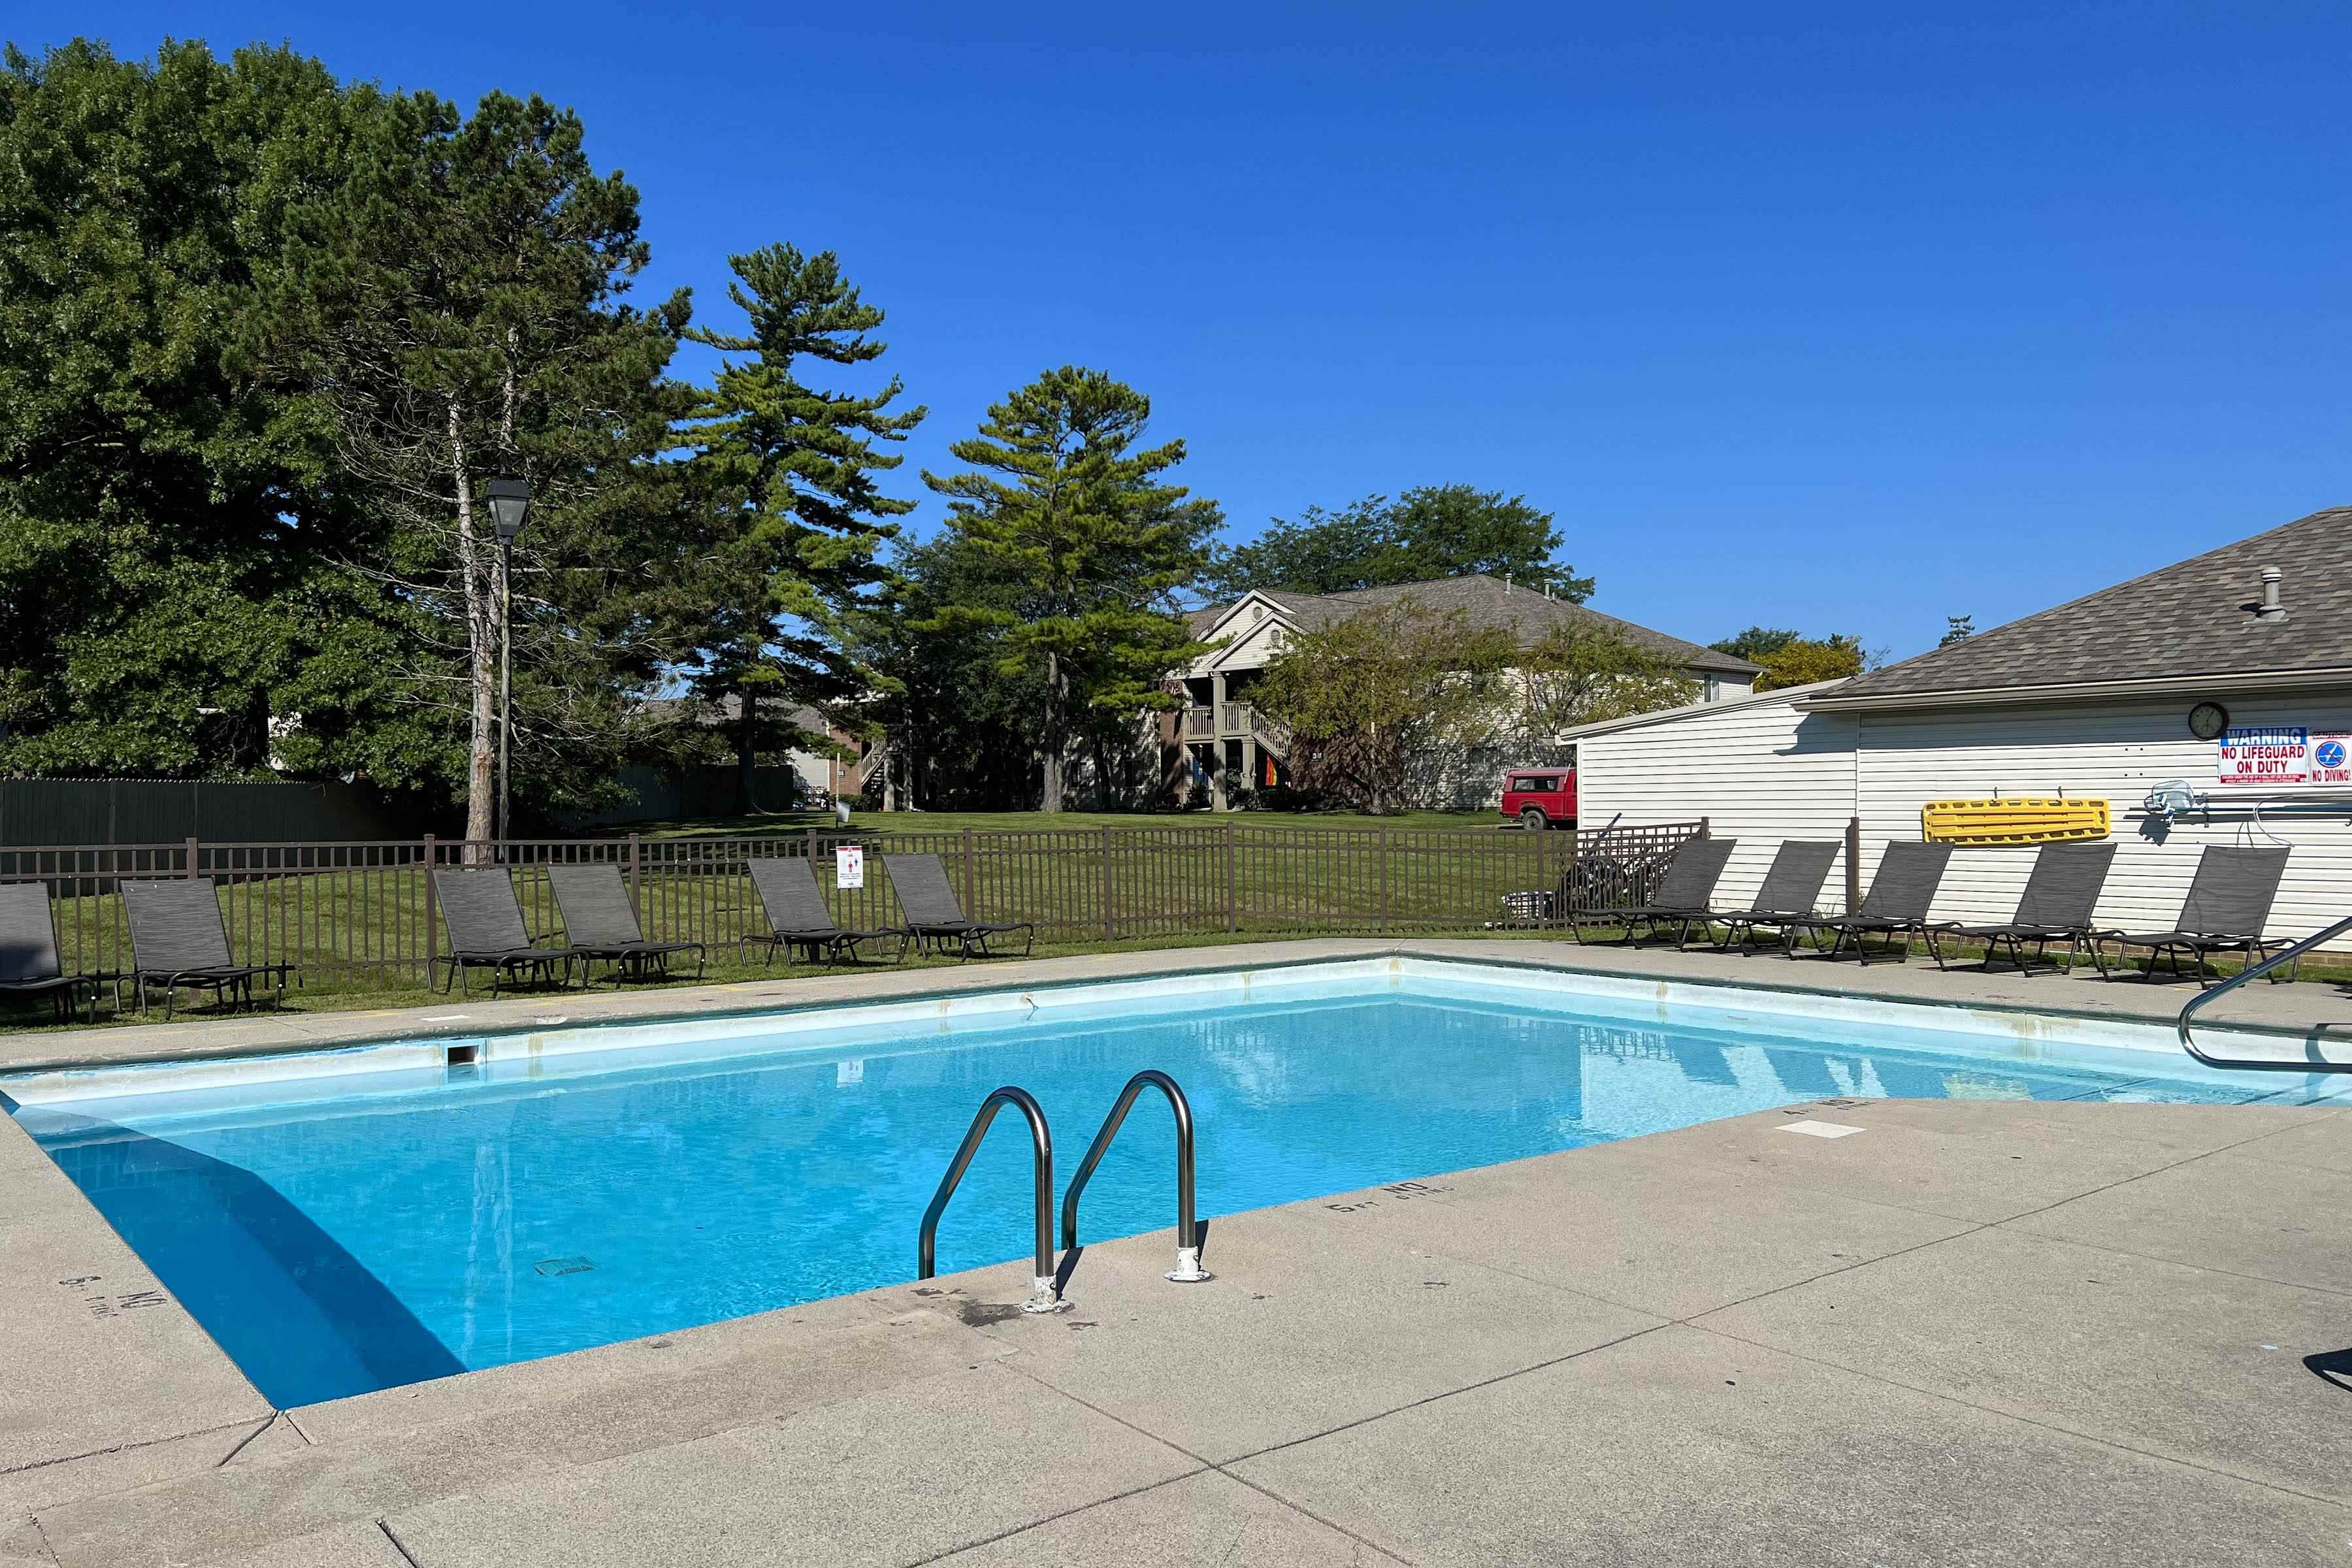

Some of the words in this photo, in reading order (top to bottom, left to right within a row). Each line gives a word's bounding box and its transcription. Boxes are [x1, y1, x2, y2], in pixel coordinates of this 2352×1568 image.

[2227, 728, 2302, 746] WARNING
[2222, 747, 2236, 760] NO
[2242, 745, 2305, 759] LIFEGUARD
[2237, 761, 2252, 774] ON
[2258, 760, 2288, 773] DUTY
[2313, 770, 2322, 782] NO
[2325, 769, 2351, 782] DIVING!
[1380, 1183, 1429, 1194] NO
[1324, 1203, 1356, 1213] 5
[116, 1290, 168, 1309] NO
